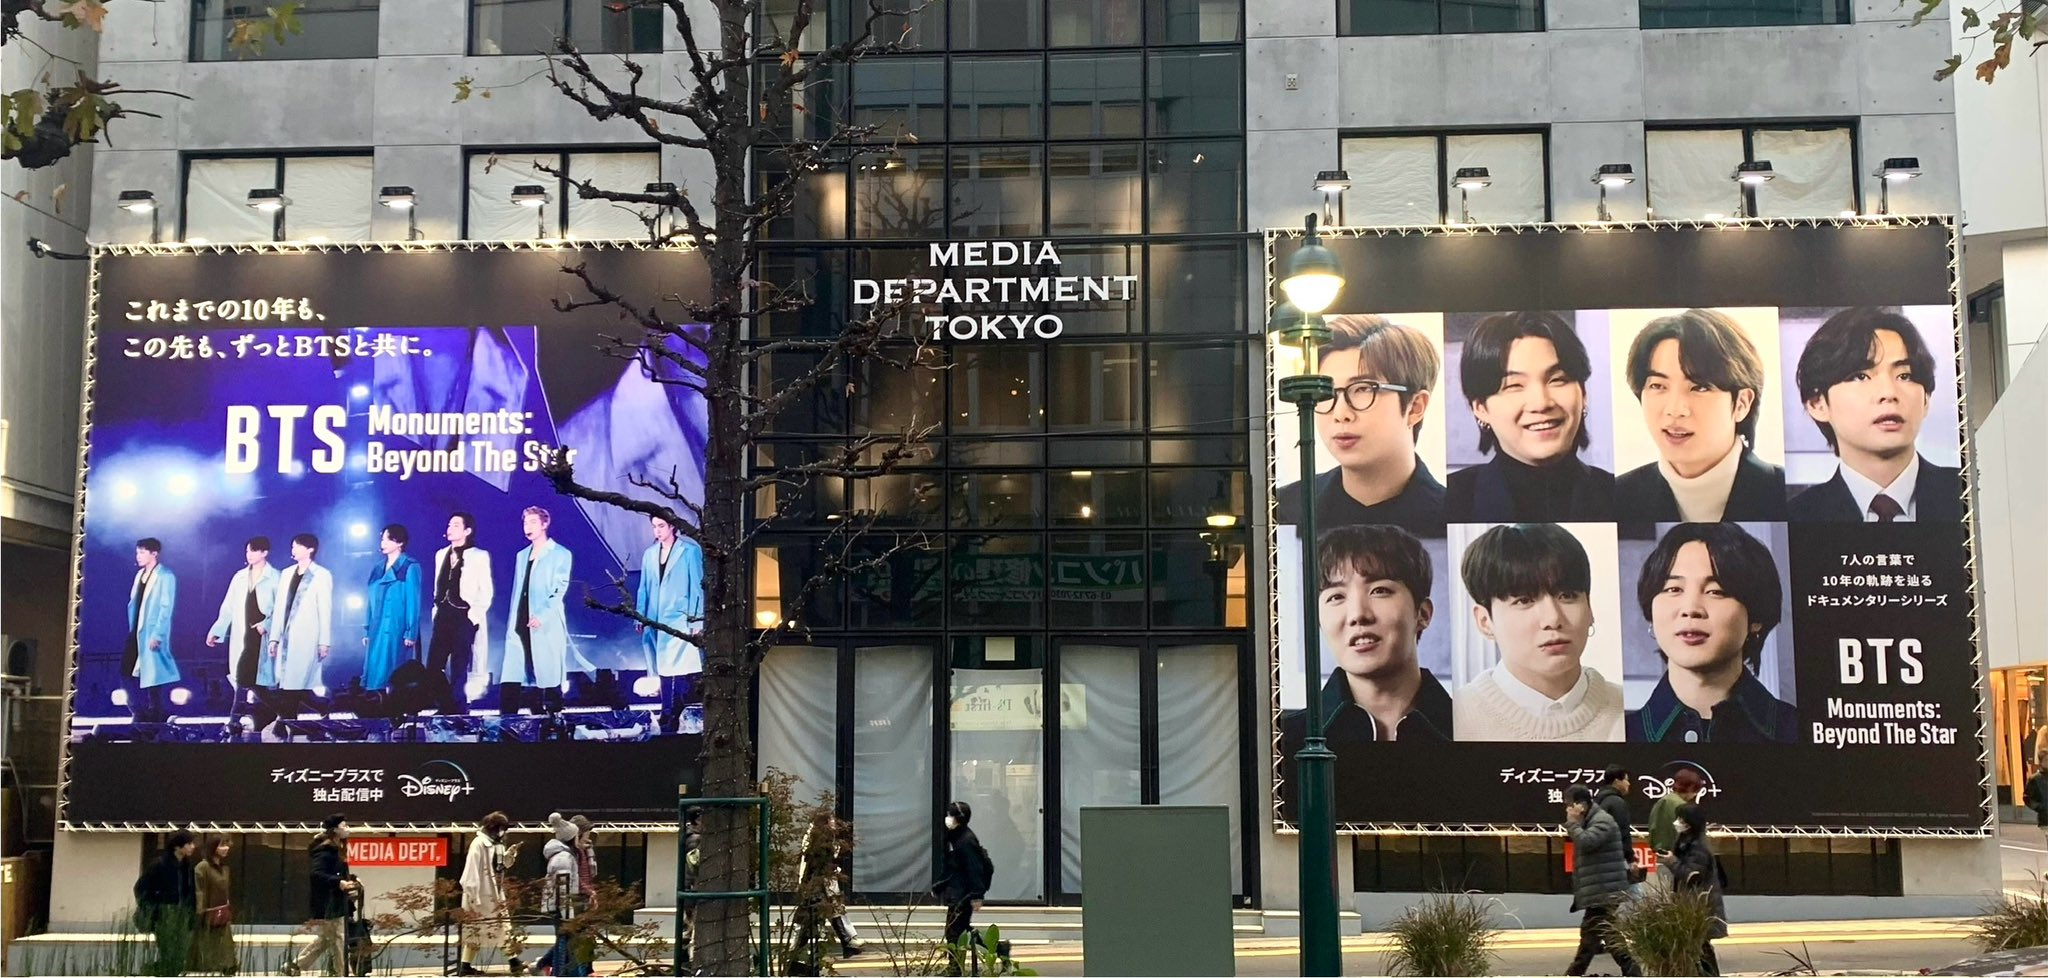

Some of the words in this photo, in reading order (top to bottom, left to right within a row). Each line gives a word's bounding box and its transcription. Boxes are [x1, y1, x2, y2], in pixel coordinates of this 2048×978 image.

[929, 240, 1062, 267] MEDIA
[853, 274, 1138, 304] DEPARTMENT
[125, 297, 326, 322] これまでの10年も、
[924, 314, 1064, 341] TOKYO
[123, 333, 434, 360] この先も、ずっとBTSと共に。
[368, 404, 533, 436] Monuments:
[224, 404, 347, 475] BTS
[367, 441, 464, 481] Beyond
[471, 440, 518, 472] The
[1840, 554, 1916, 567] 7人の言葉で
[1822, 574, 1933, 588] 10年の軌跡を辿る
[1807, 594, 1949, 607] ドキュメンタリーシリーズ
[1838, 637, 1925, 685] BTS
[1827, 697, 1942, 719] Monuments:
[1812, 722, 1881, 750] Beyond
[1883, 723, 1917, 744] The
[1920, 722, 1958, 745] Star
[270, 767, 384, 783] ディズニープラスで
[1500, 768, 1606, 784] ディズニープラス
[313, 787, 384, 803] 独占配信中
[347, 842, 394, 862] MEDIA
[398, 842, 441, 862] DEPT.
